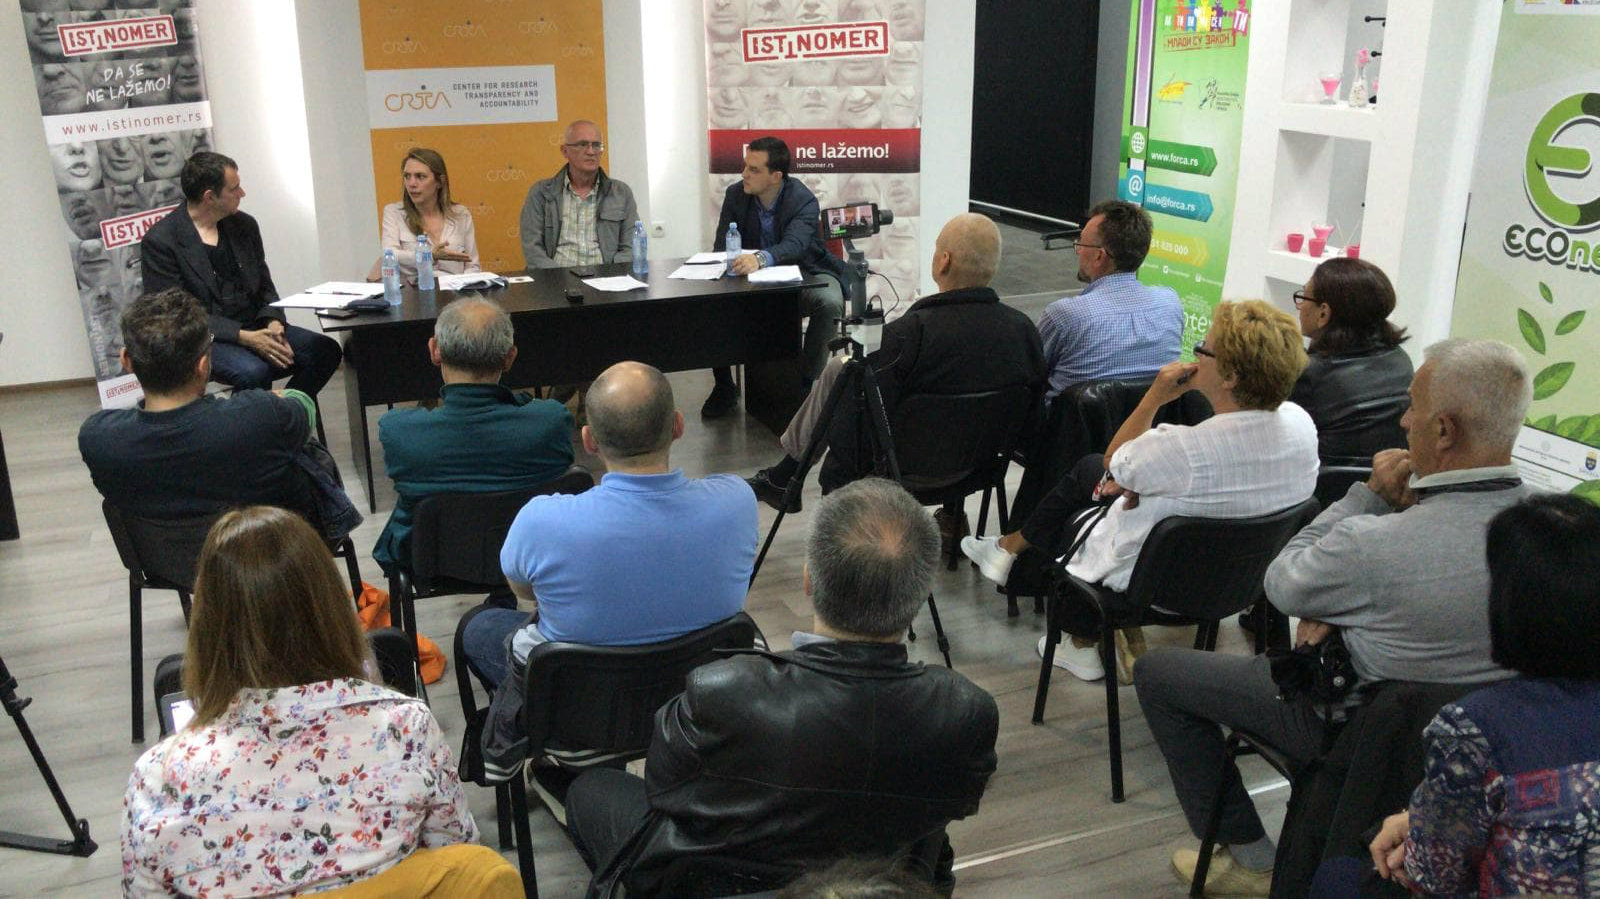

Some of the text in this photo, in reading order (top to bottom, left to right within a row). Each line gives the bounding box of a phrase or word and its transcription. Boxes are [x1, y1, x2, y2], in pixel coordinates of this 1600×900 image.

[69, 23, 169, 50] ISTINOMER
[752, 29, 879, 59] ISTINOMER
[104, 63, 144, 82] DA SE
[86, 75, 171, 105] NE LAŽEMO!
[453, 80, 538, 92] CENTER FOR RESEARCH
[465, 90, 539, 100] TRANSPARENCY AND
[480, 99, 539, 109] ACCOUNTABILITY
[62, 112, 202, 135] www.istinomer.rs
[796, 142, 889, 159] ne lažemo!
[1150, 151, 1199, 167] www.forca.rs
[796, 162, 834, 170] istinomer.rs
[1146, 195, 1196, 212] info@forca.rs
